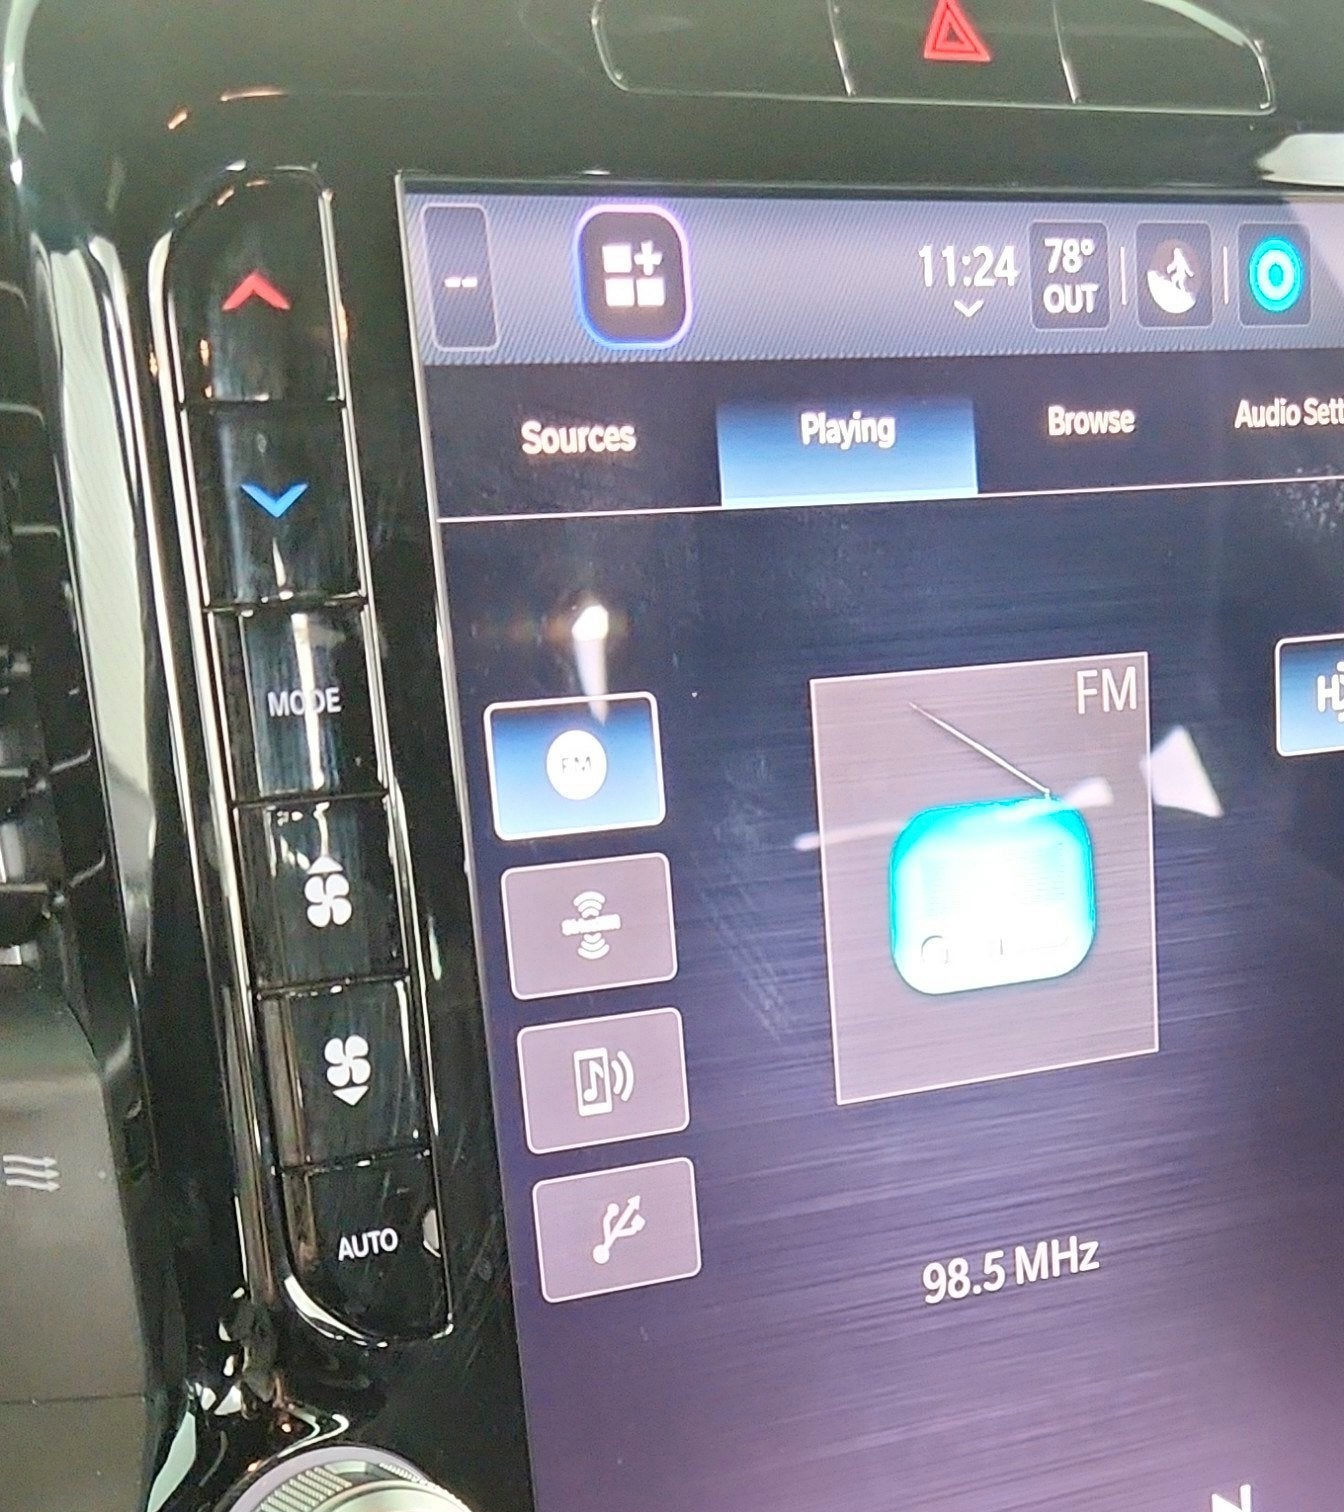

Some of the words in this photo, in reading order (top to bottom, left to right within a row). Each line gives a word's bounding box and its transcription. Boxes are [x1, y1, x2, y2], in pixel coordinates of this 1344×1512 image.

[918, 244, 1020, 288] 11:24
[1042, 282, 1100, 315] OUT
[799, 410, 897, 451] Playing
[1047, 404, 1136, 437] Browse
[1233, 397, 1302, 430] Audio
[520, 419, 638, 456] Sources
[267, 686, 343, 728] MODE
[1075, 665, 1138, 715] FM
[337, 1226, 399, 1261] AUTO
[922, 1249, 1006, 1305] 98.5
[1014, 1235, 1090, 1286] MHz
